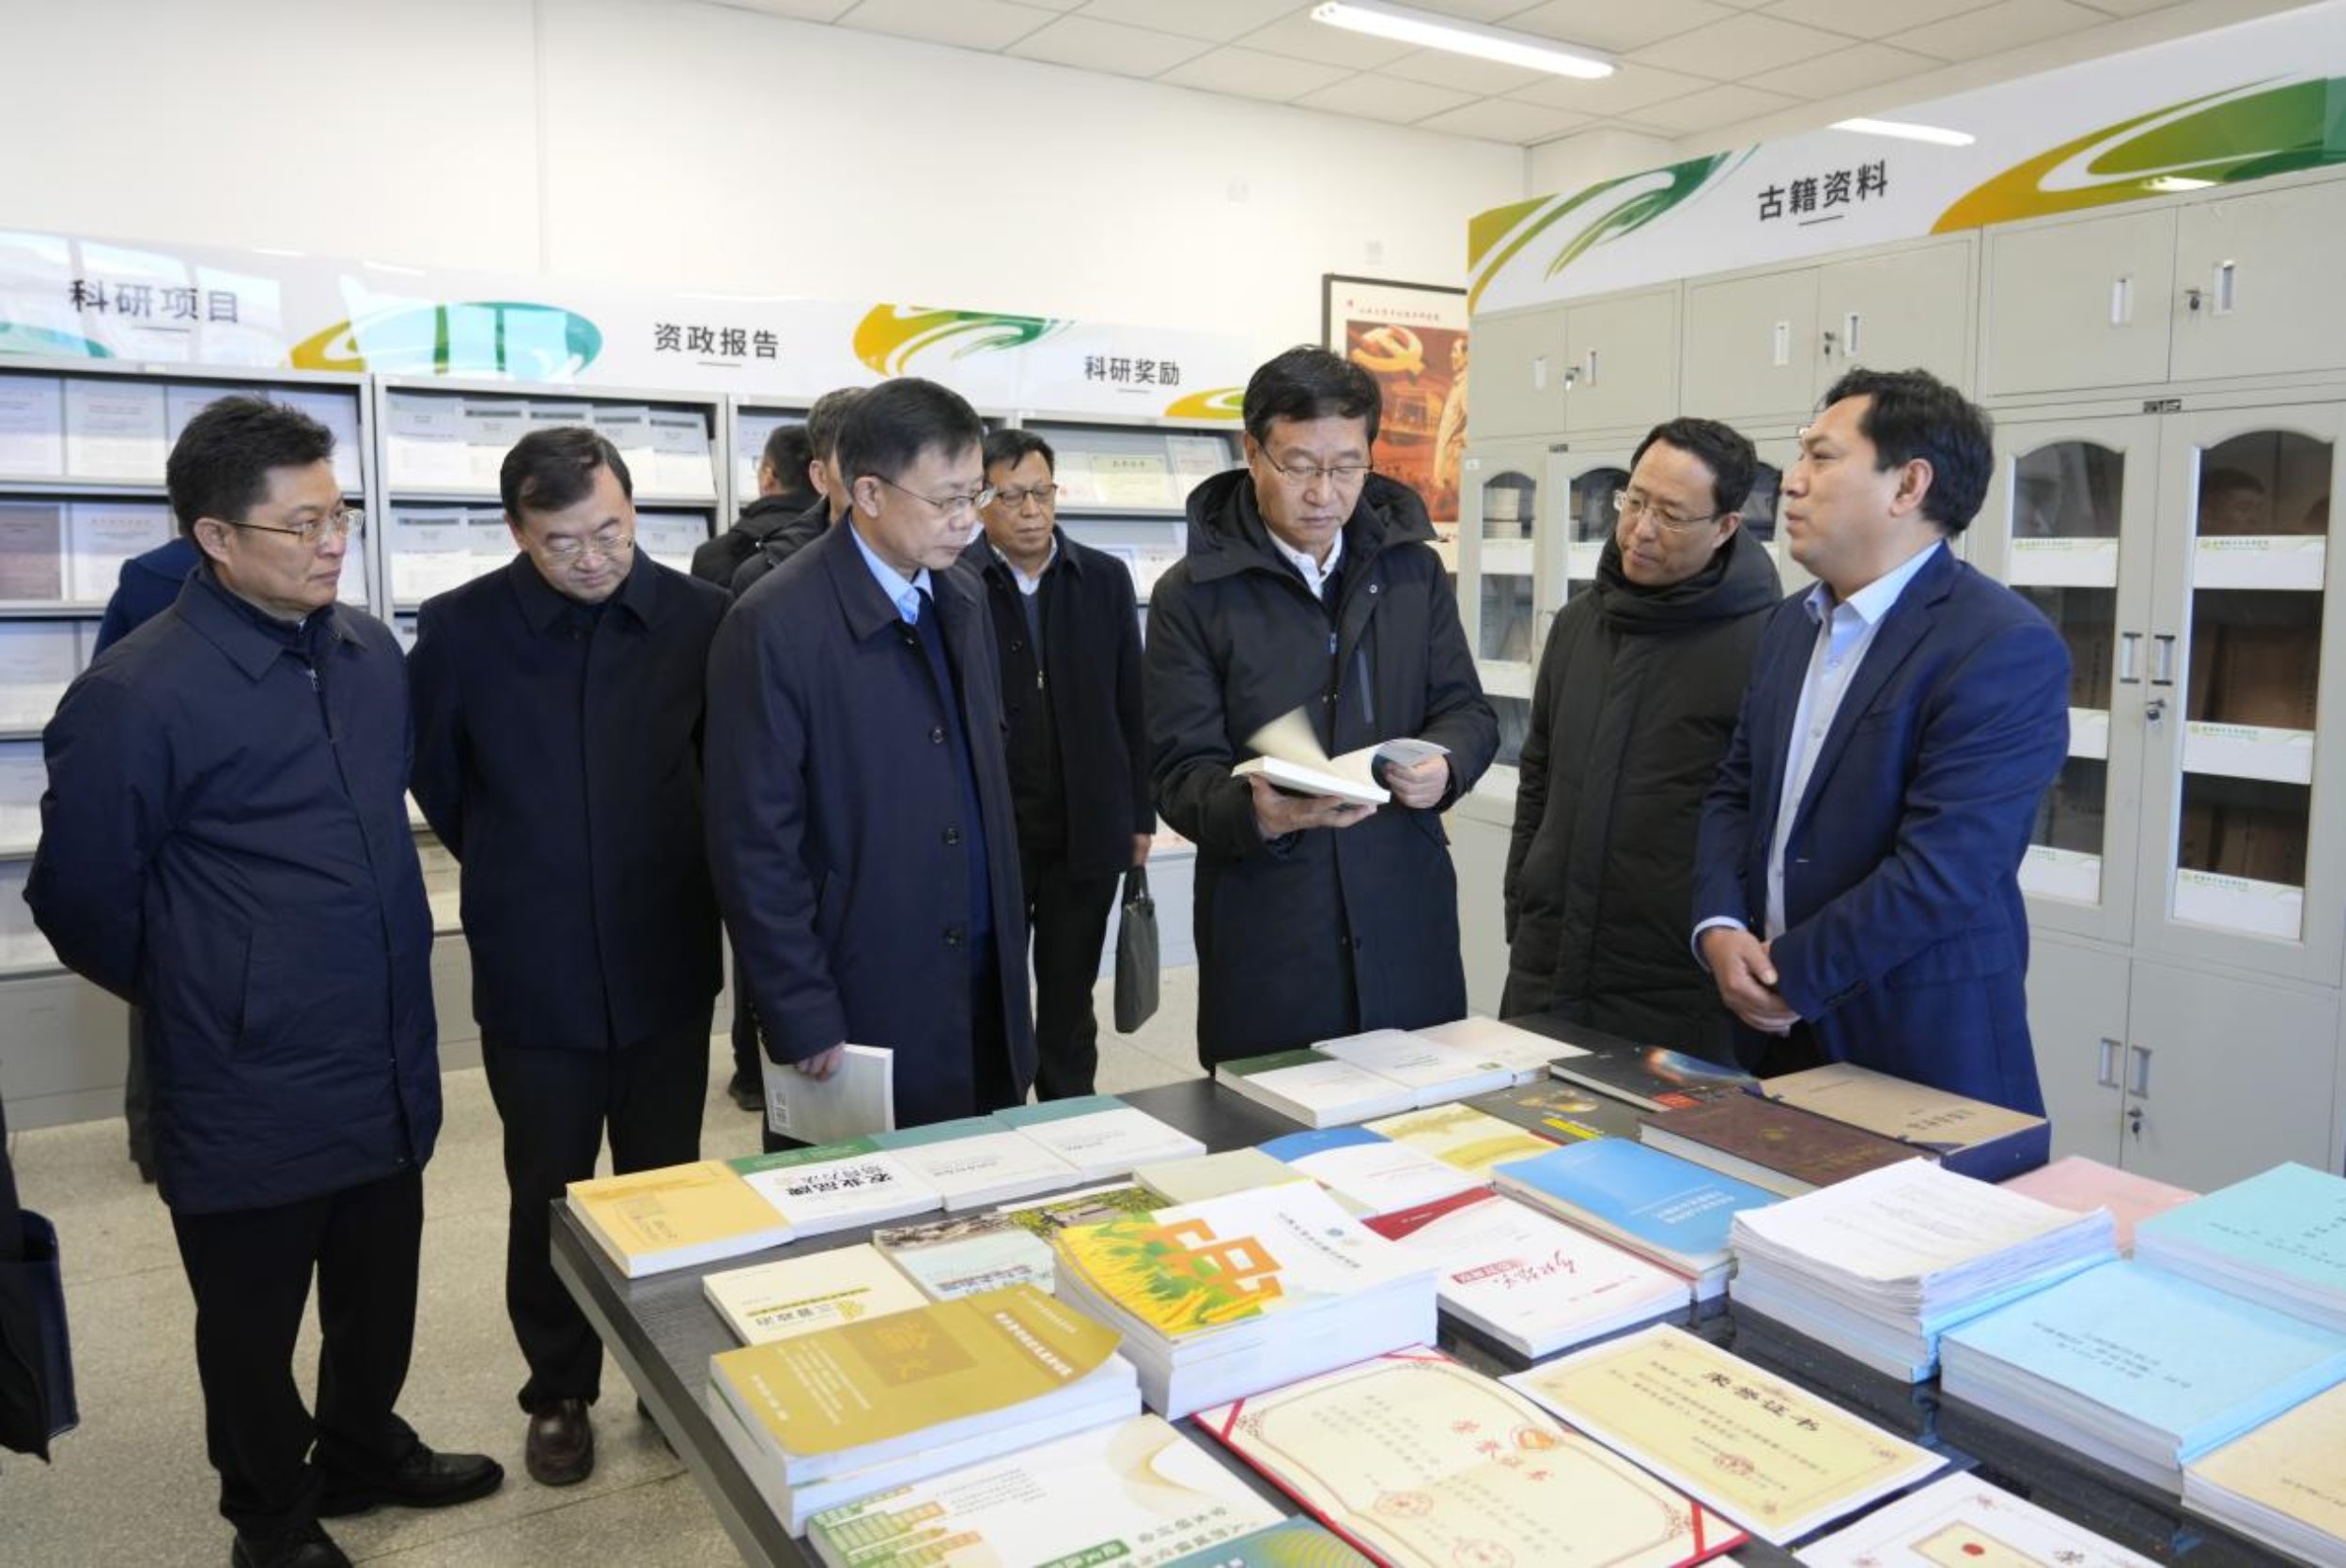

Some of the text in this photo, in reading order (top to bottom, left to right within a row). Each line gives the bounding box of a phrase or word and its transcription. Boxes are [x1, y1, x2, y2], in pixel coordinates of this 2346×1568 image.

[1757, 160, 1888, 222] 古籍资料
[70, 279, 239, 322] 科研项目
[654, 322, 779, 359] 资政报告
[1084, 355, 1181, 385] 科研奖励
